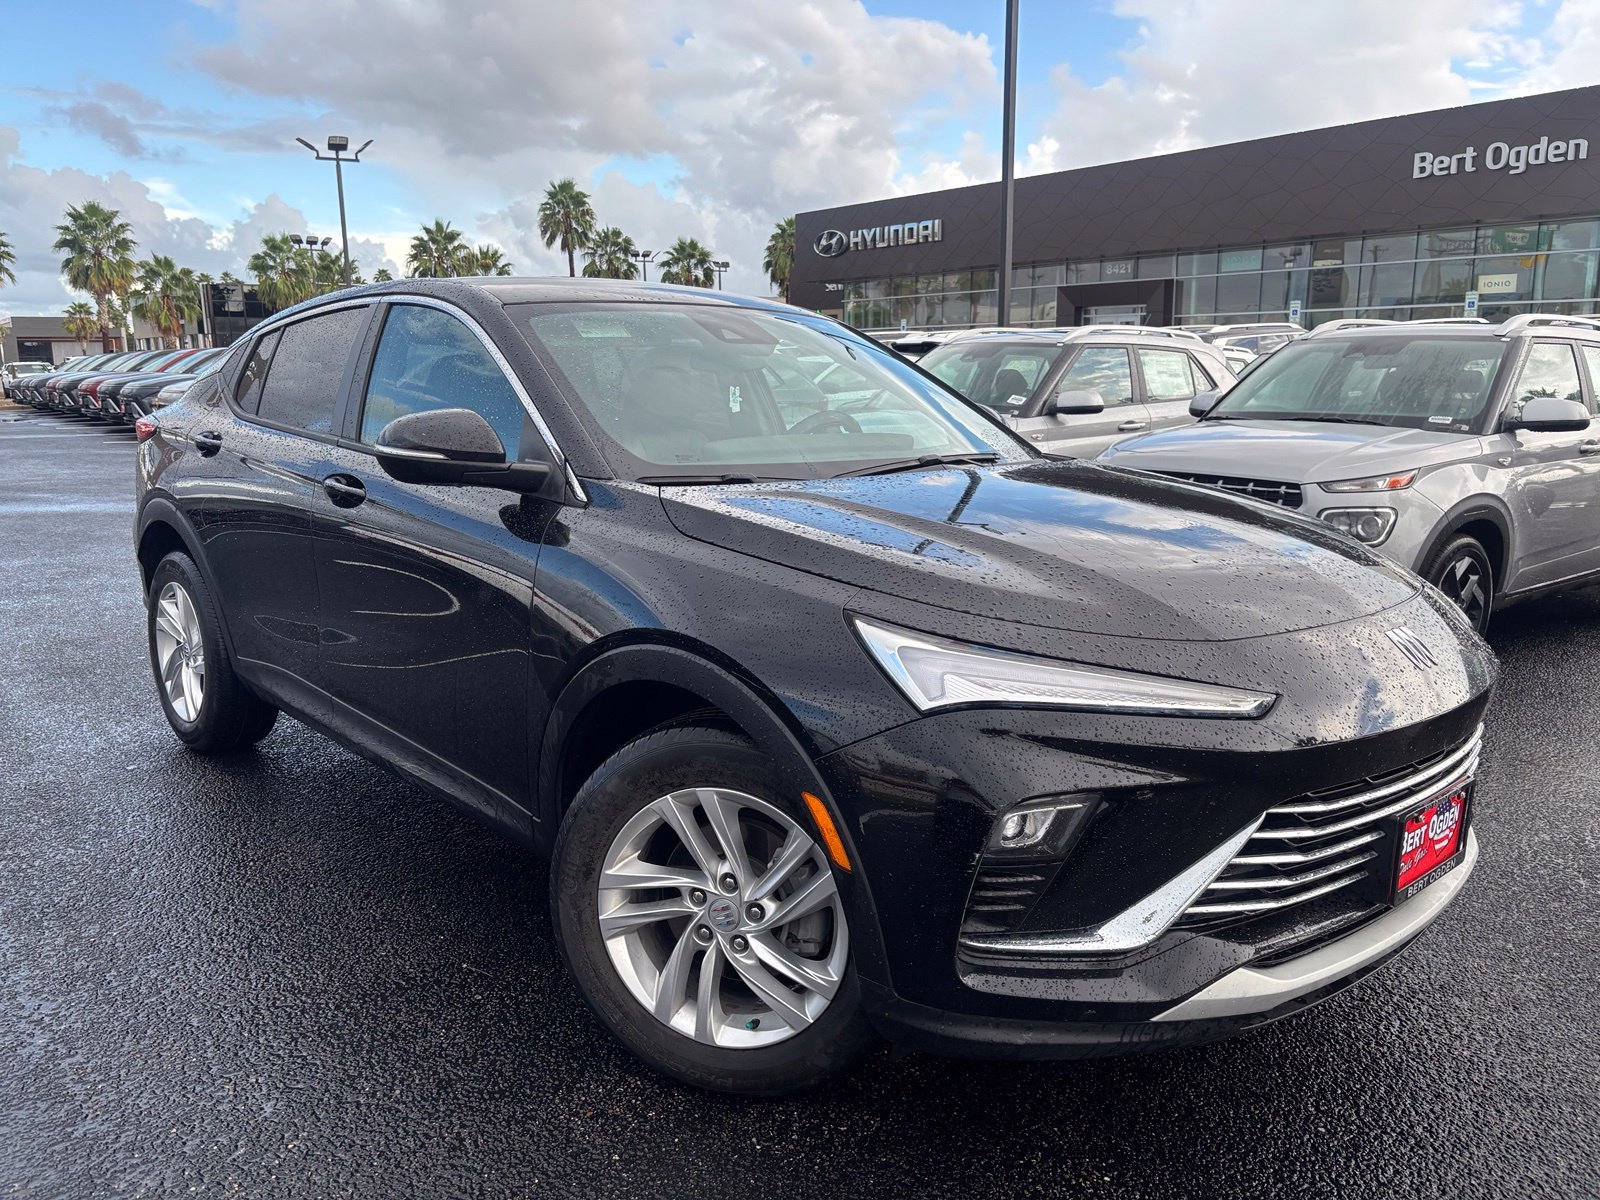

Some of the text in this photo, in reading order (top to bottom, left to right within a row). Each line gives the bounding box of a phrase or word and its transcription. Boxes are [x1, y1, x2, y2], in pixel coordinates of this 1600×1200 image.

[1412, 135, 1589, 179] Bert Ogden
[849, 219, 943, 251] HYUNDAI
[1106, 263, 1131, 274] 8421
[1428, 803, 1461, 840] OGDEN
[1407, 858, 1457, 898] BERT OGDEN
